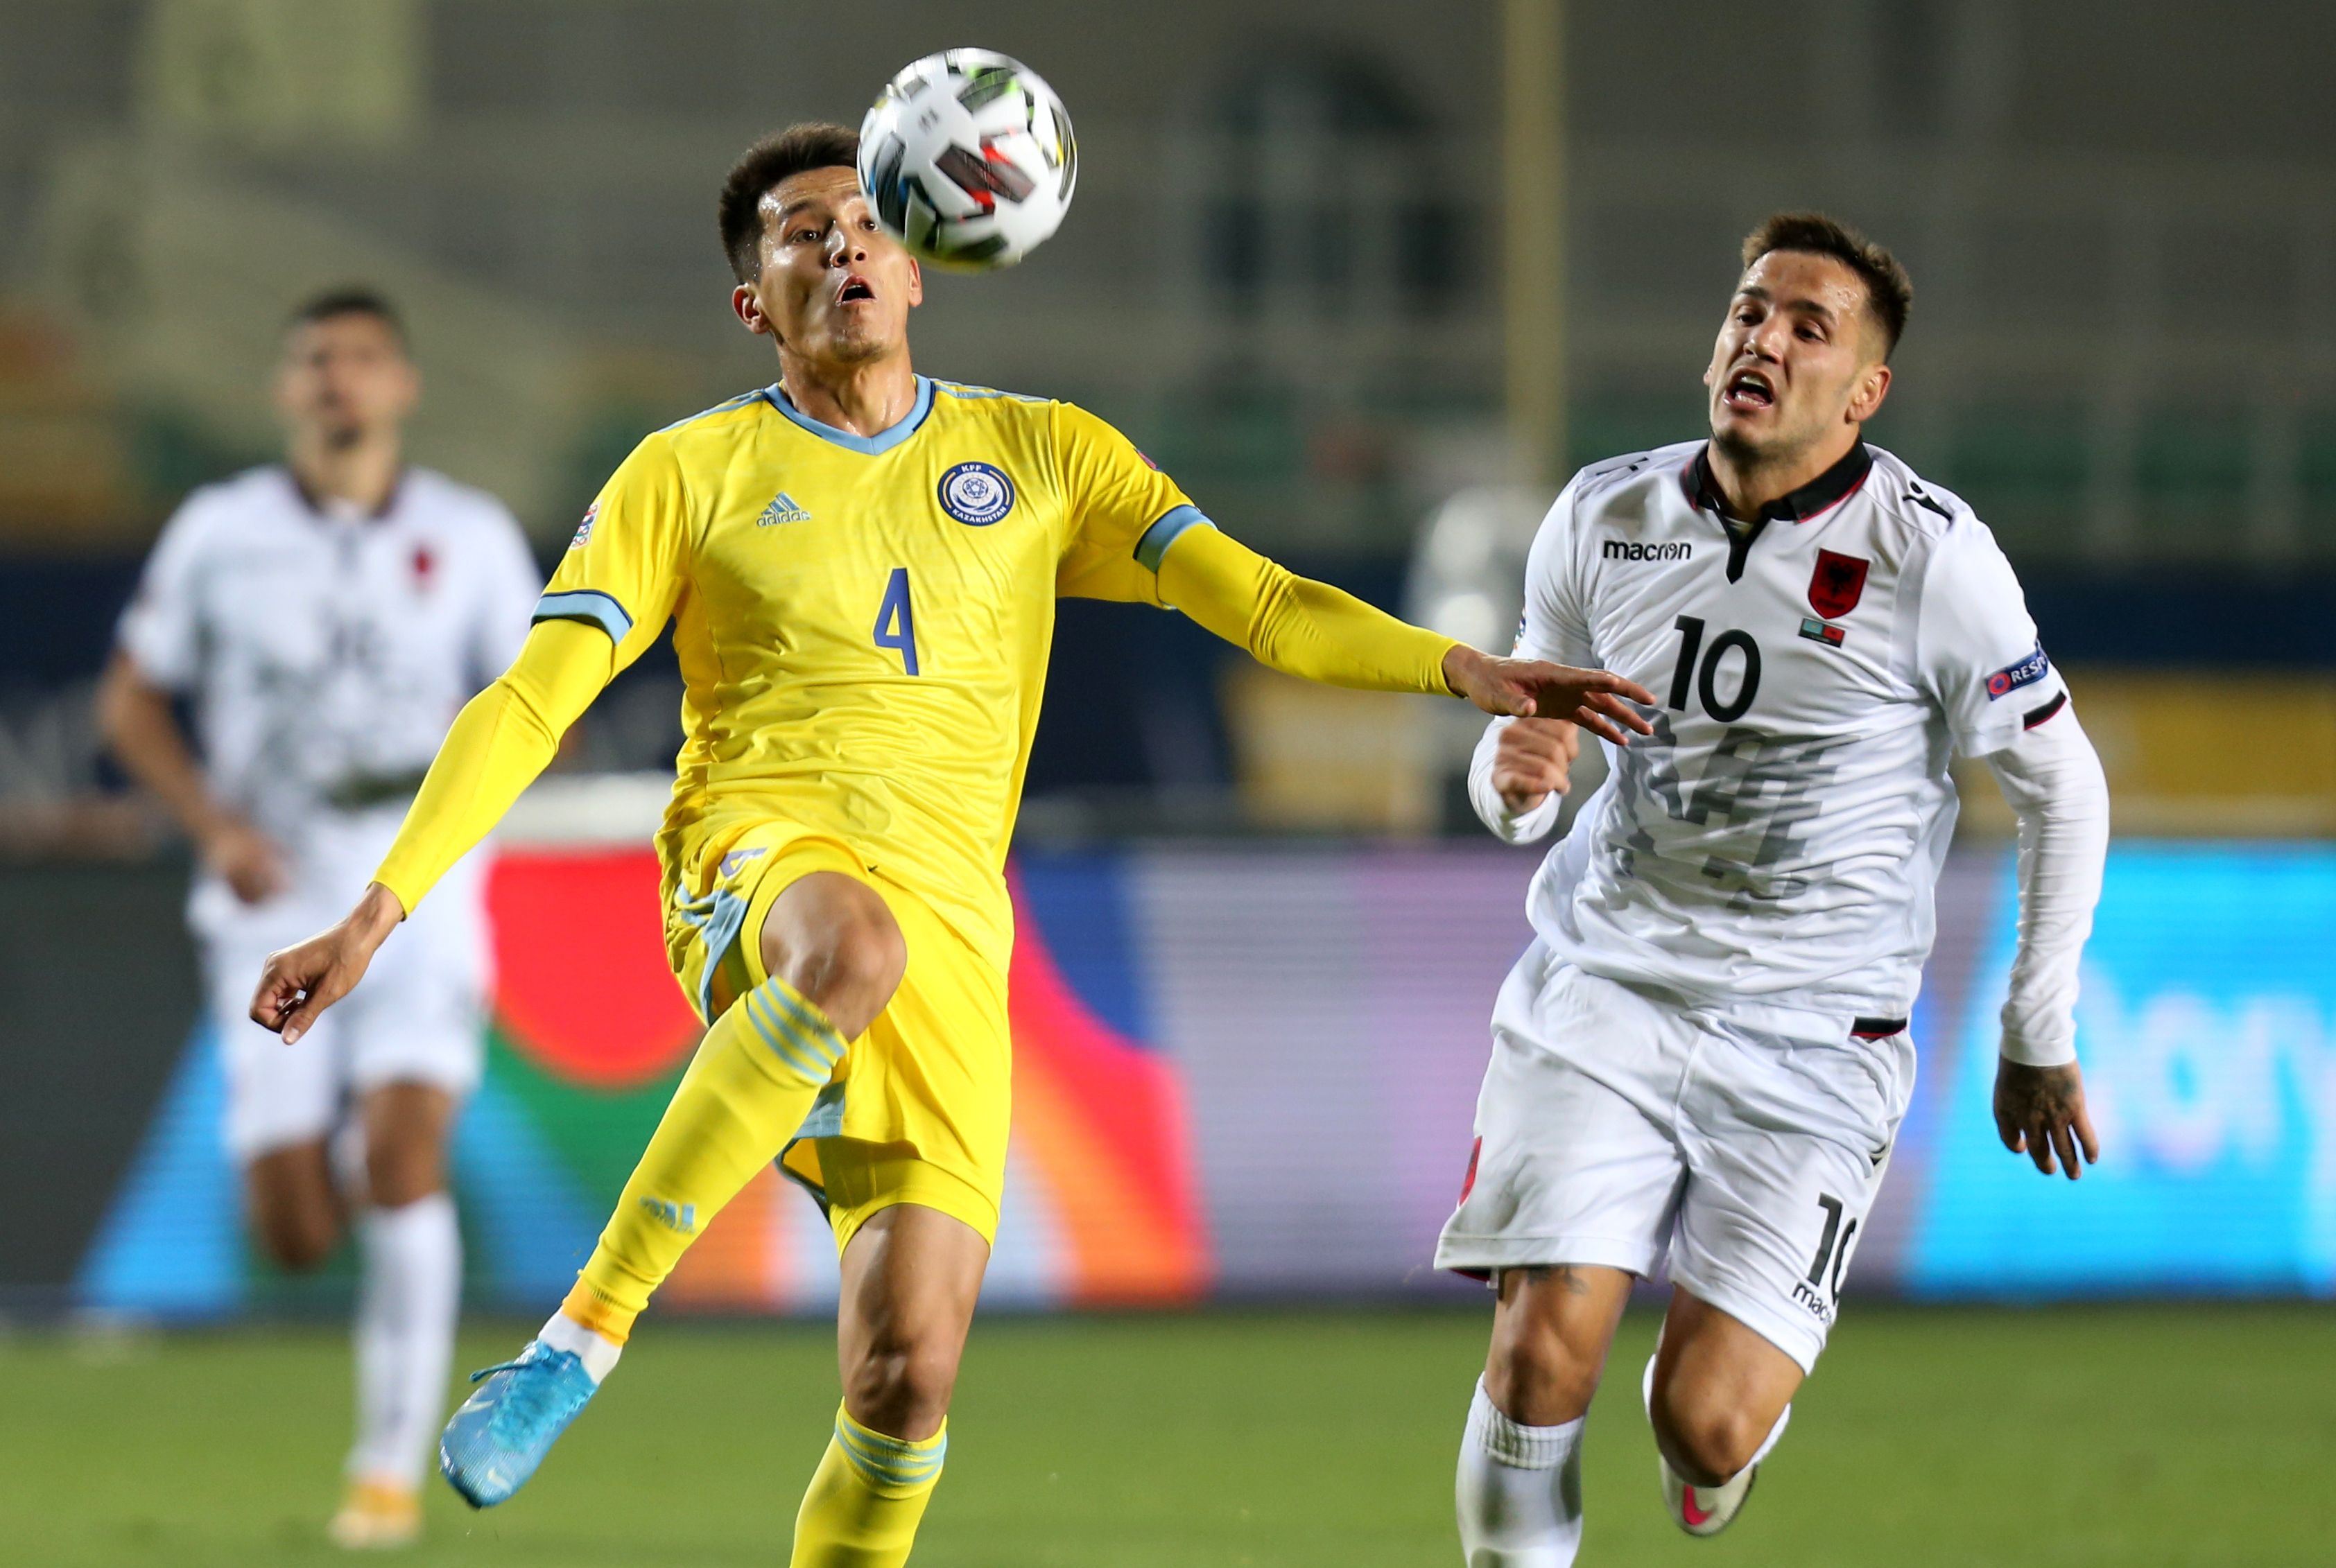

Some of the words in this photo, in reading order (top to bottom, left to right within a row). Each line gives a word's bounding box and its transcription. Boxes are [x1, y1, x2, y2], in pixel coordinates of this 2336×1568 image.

[756, 511, 810, 527] adidas
[952, 506, 1007, 523] KAZAKHSTAN
[1603, 540, 1692, 561] macron
[873, 568, 919, 676] 4
[1668, 614, 1762, 722] 10
[2011, 655, 2047, 683] RESP
